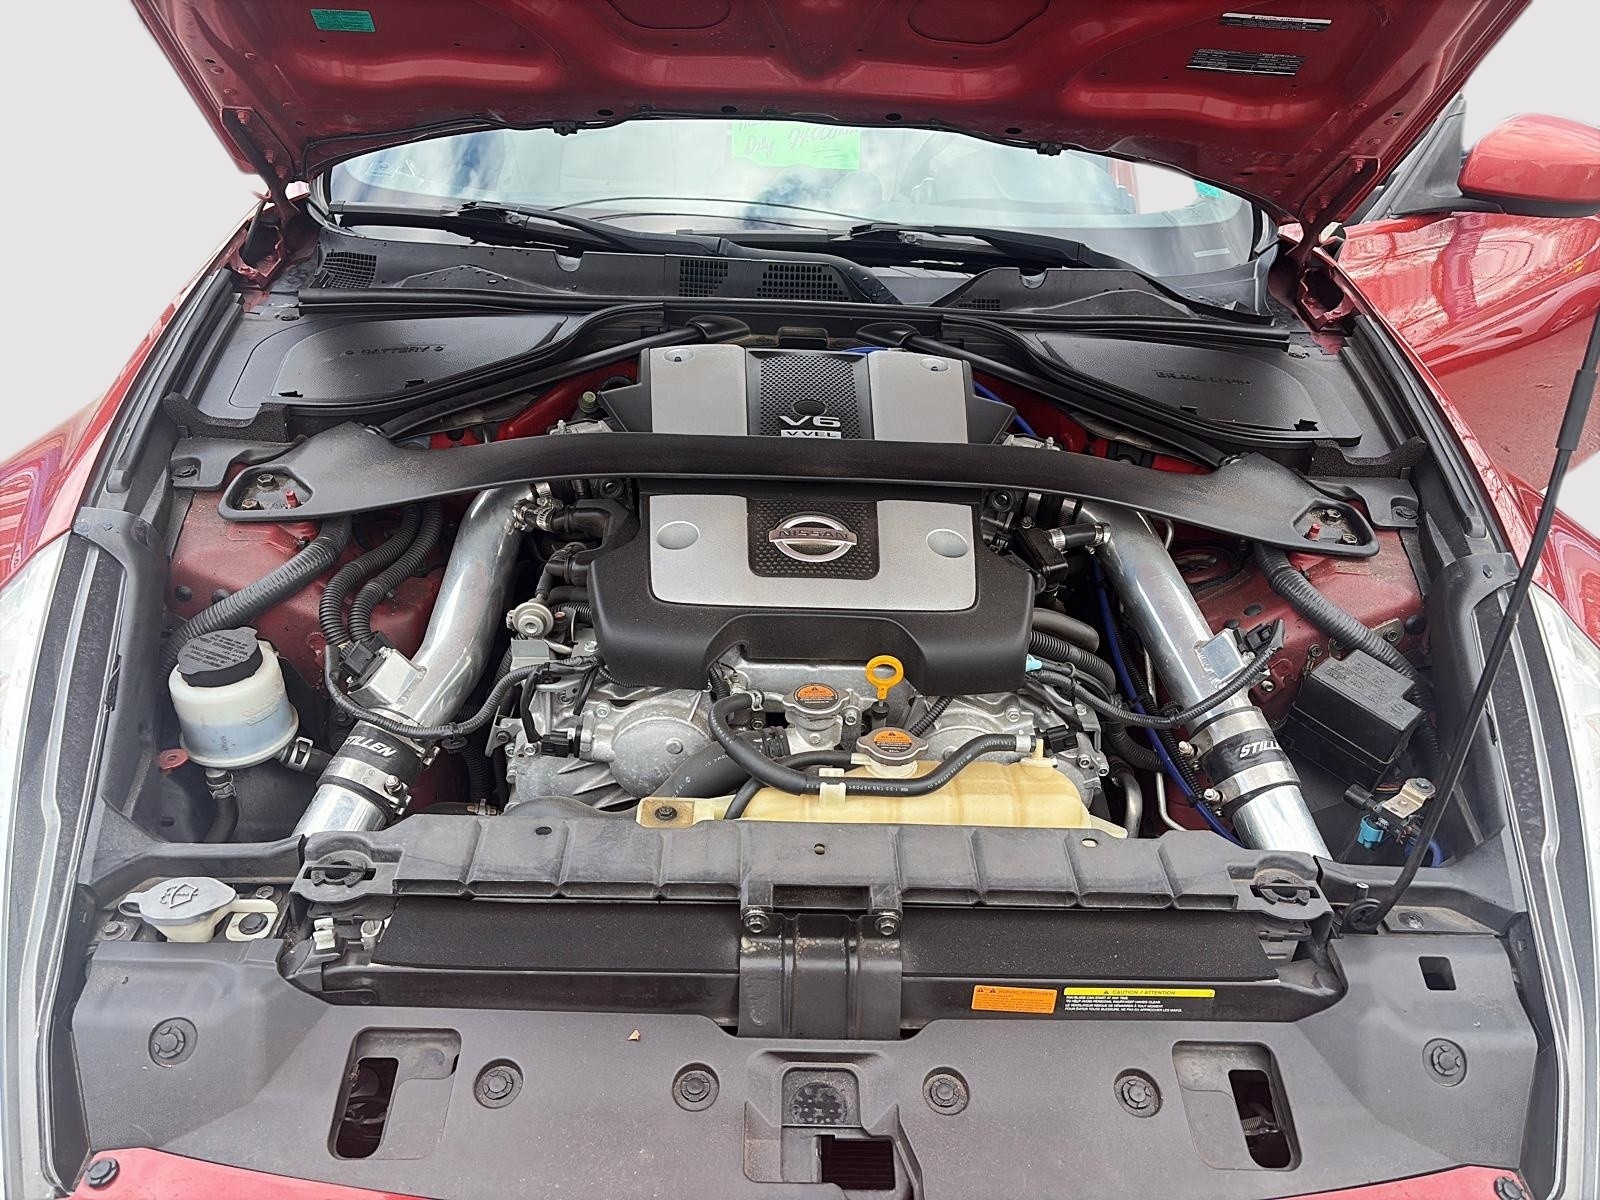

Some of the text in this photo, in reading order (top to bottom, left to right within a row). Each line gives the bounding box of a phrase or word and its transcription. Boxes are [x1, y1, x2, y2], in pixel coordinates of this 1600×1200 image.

[779, 415, 841, 428] V6
[786, 430, 837, 438] VVEL
[779, 529, 848, 539] NISSAN
